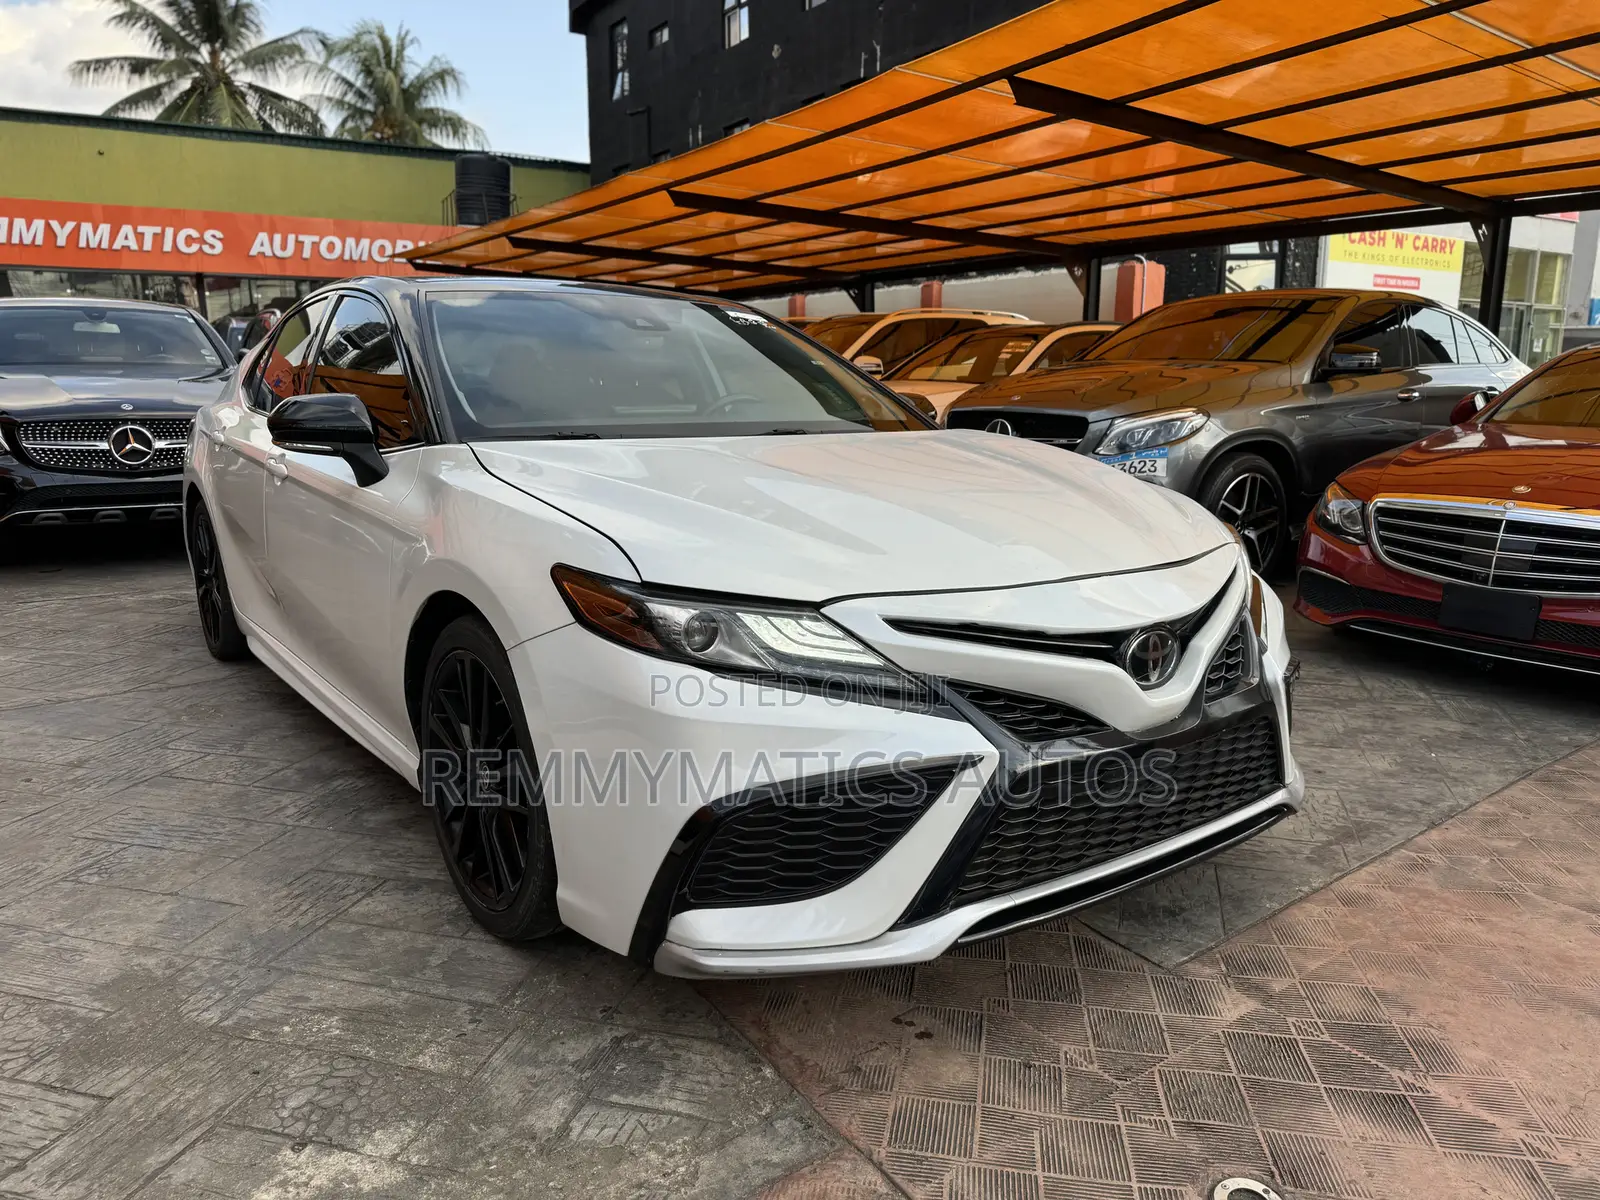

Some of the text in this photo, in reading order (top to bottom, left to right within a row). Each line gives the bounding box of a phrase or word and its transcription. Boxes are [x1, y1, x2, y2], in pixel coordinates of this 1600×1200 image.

[0, 216, 449, 265] MYMATICS AUTOMOB
[1348, 230, 1387, 248] CASH
[1412, 234, 1456, 255] CARRY
[1343, 250, 1451, 269] THE KINGS OF ELECTRONICS
